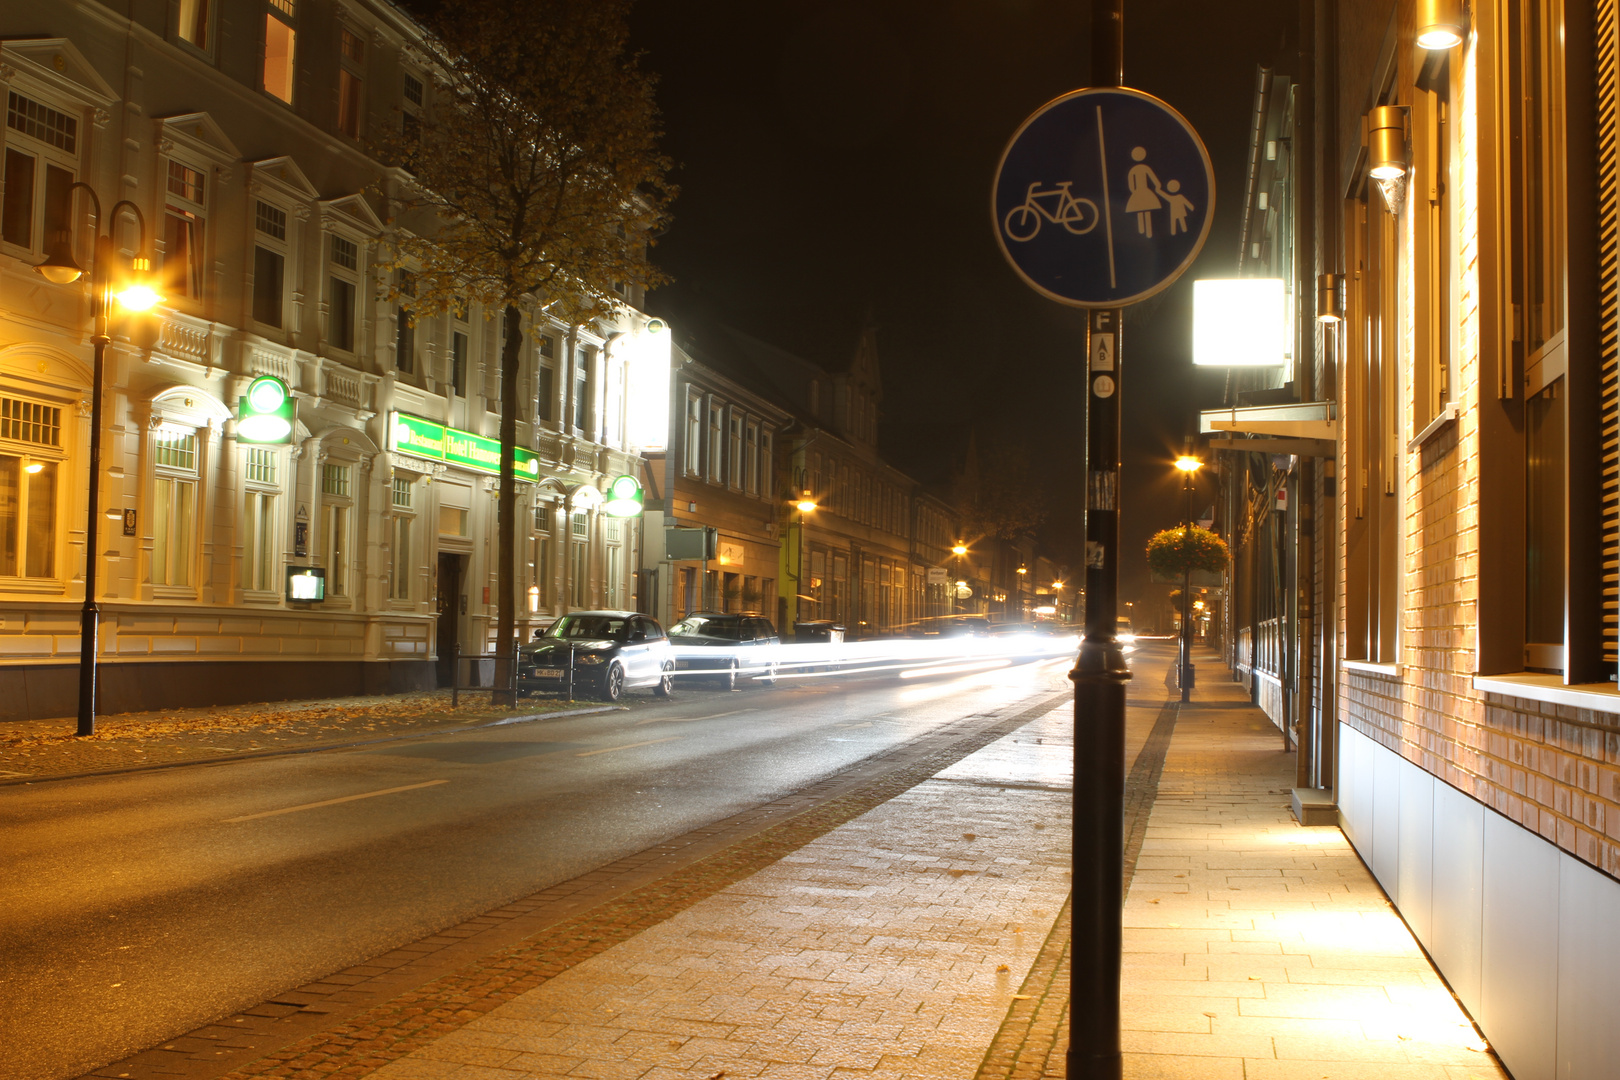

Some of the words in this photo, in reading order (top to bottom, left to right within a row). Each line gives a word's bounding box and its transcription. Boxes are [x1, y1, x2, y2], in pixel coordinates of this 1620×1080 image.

[1096, 312, 1111, 330] F
[1099, 352, 1106, 361] B
[446, 435, 467, 457] Hotel
